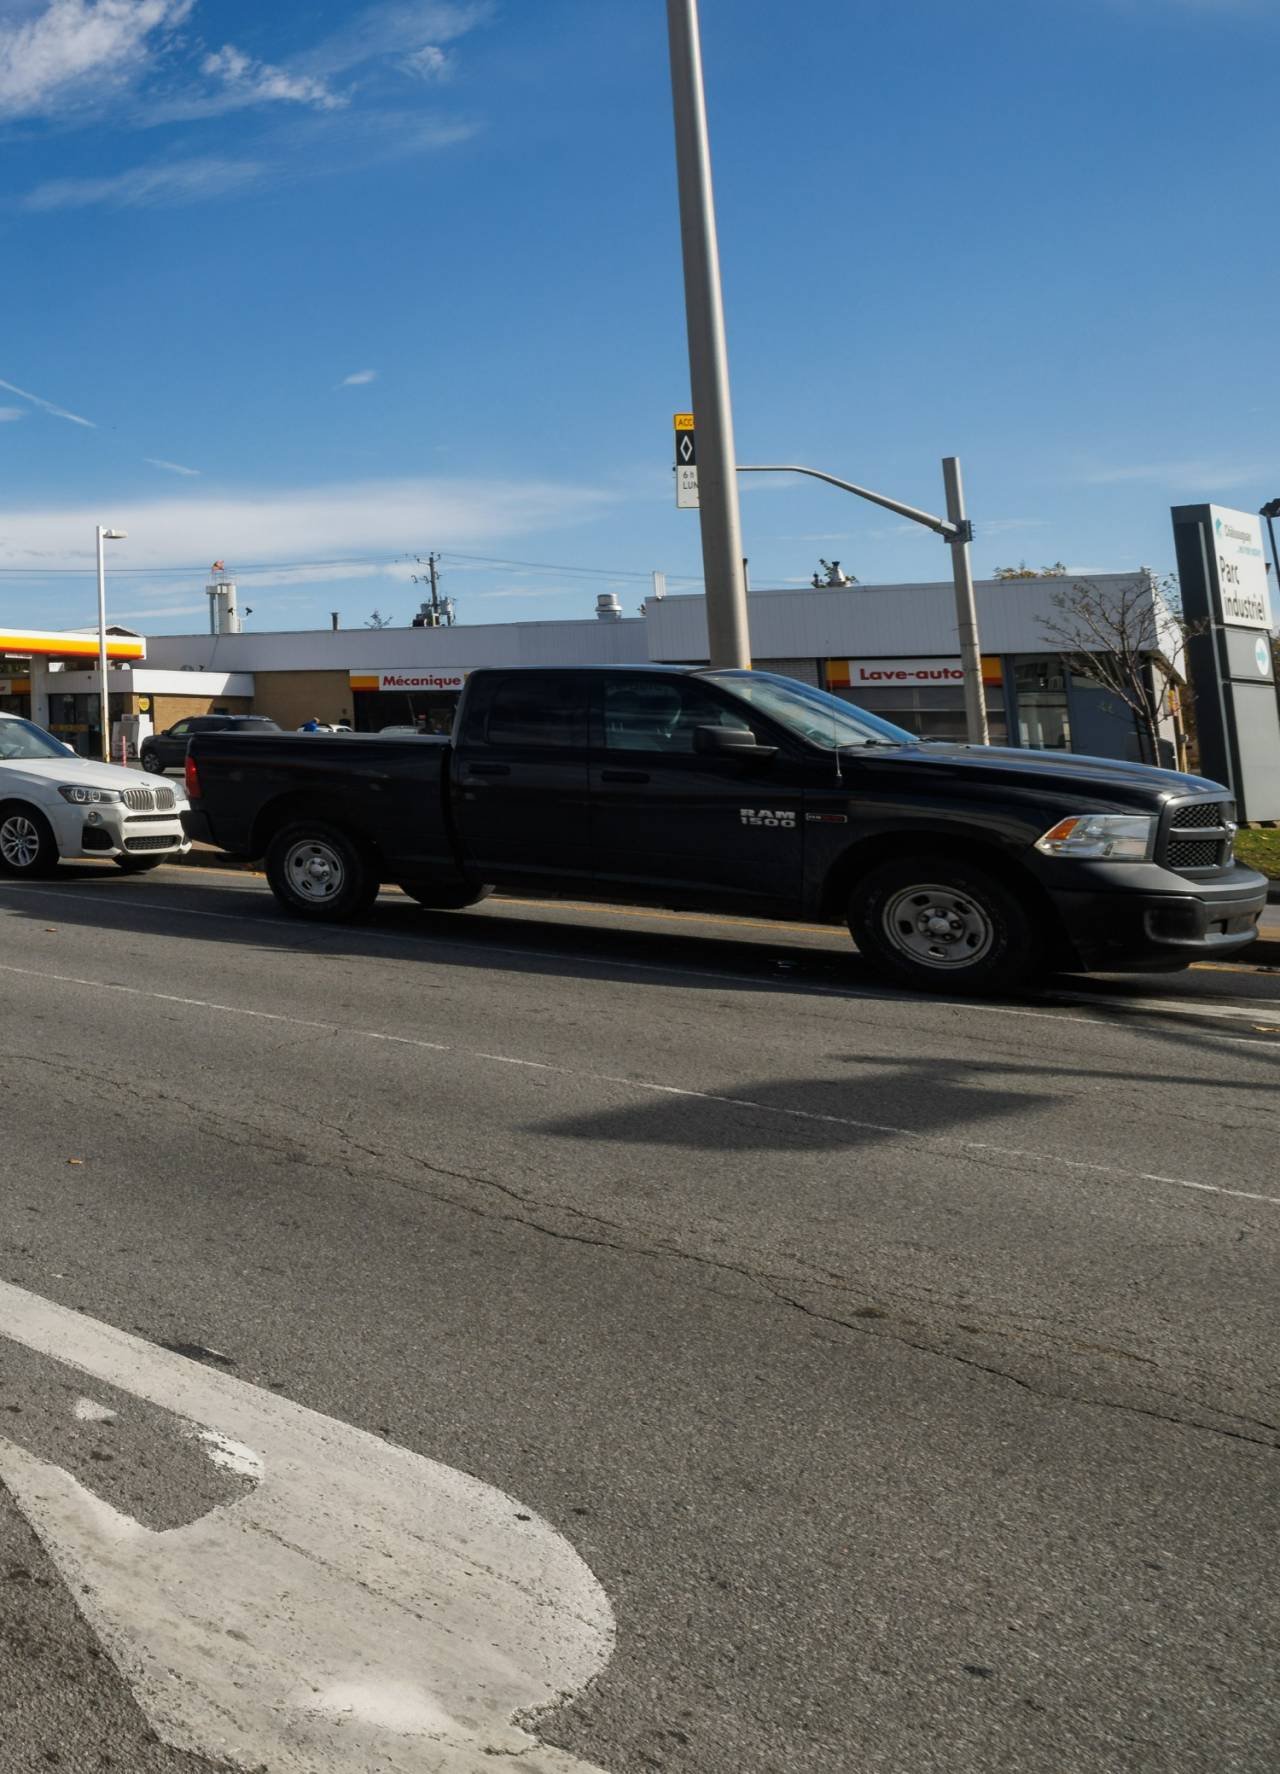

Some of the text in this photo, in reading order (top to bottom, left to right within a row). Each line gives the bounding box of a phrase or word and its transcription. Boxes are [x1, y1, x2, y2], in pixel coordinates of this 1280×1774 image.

[1219, 555, 1240, 585] Parc
[1223, 588, 1266, 621] industriel
[383, 674, 462, 688] Mécanique
[859, 667, 965, 681] Lave-auto
[740, 808, 796, 819] RAM
[740, 816, 797, 828] 1500
